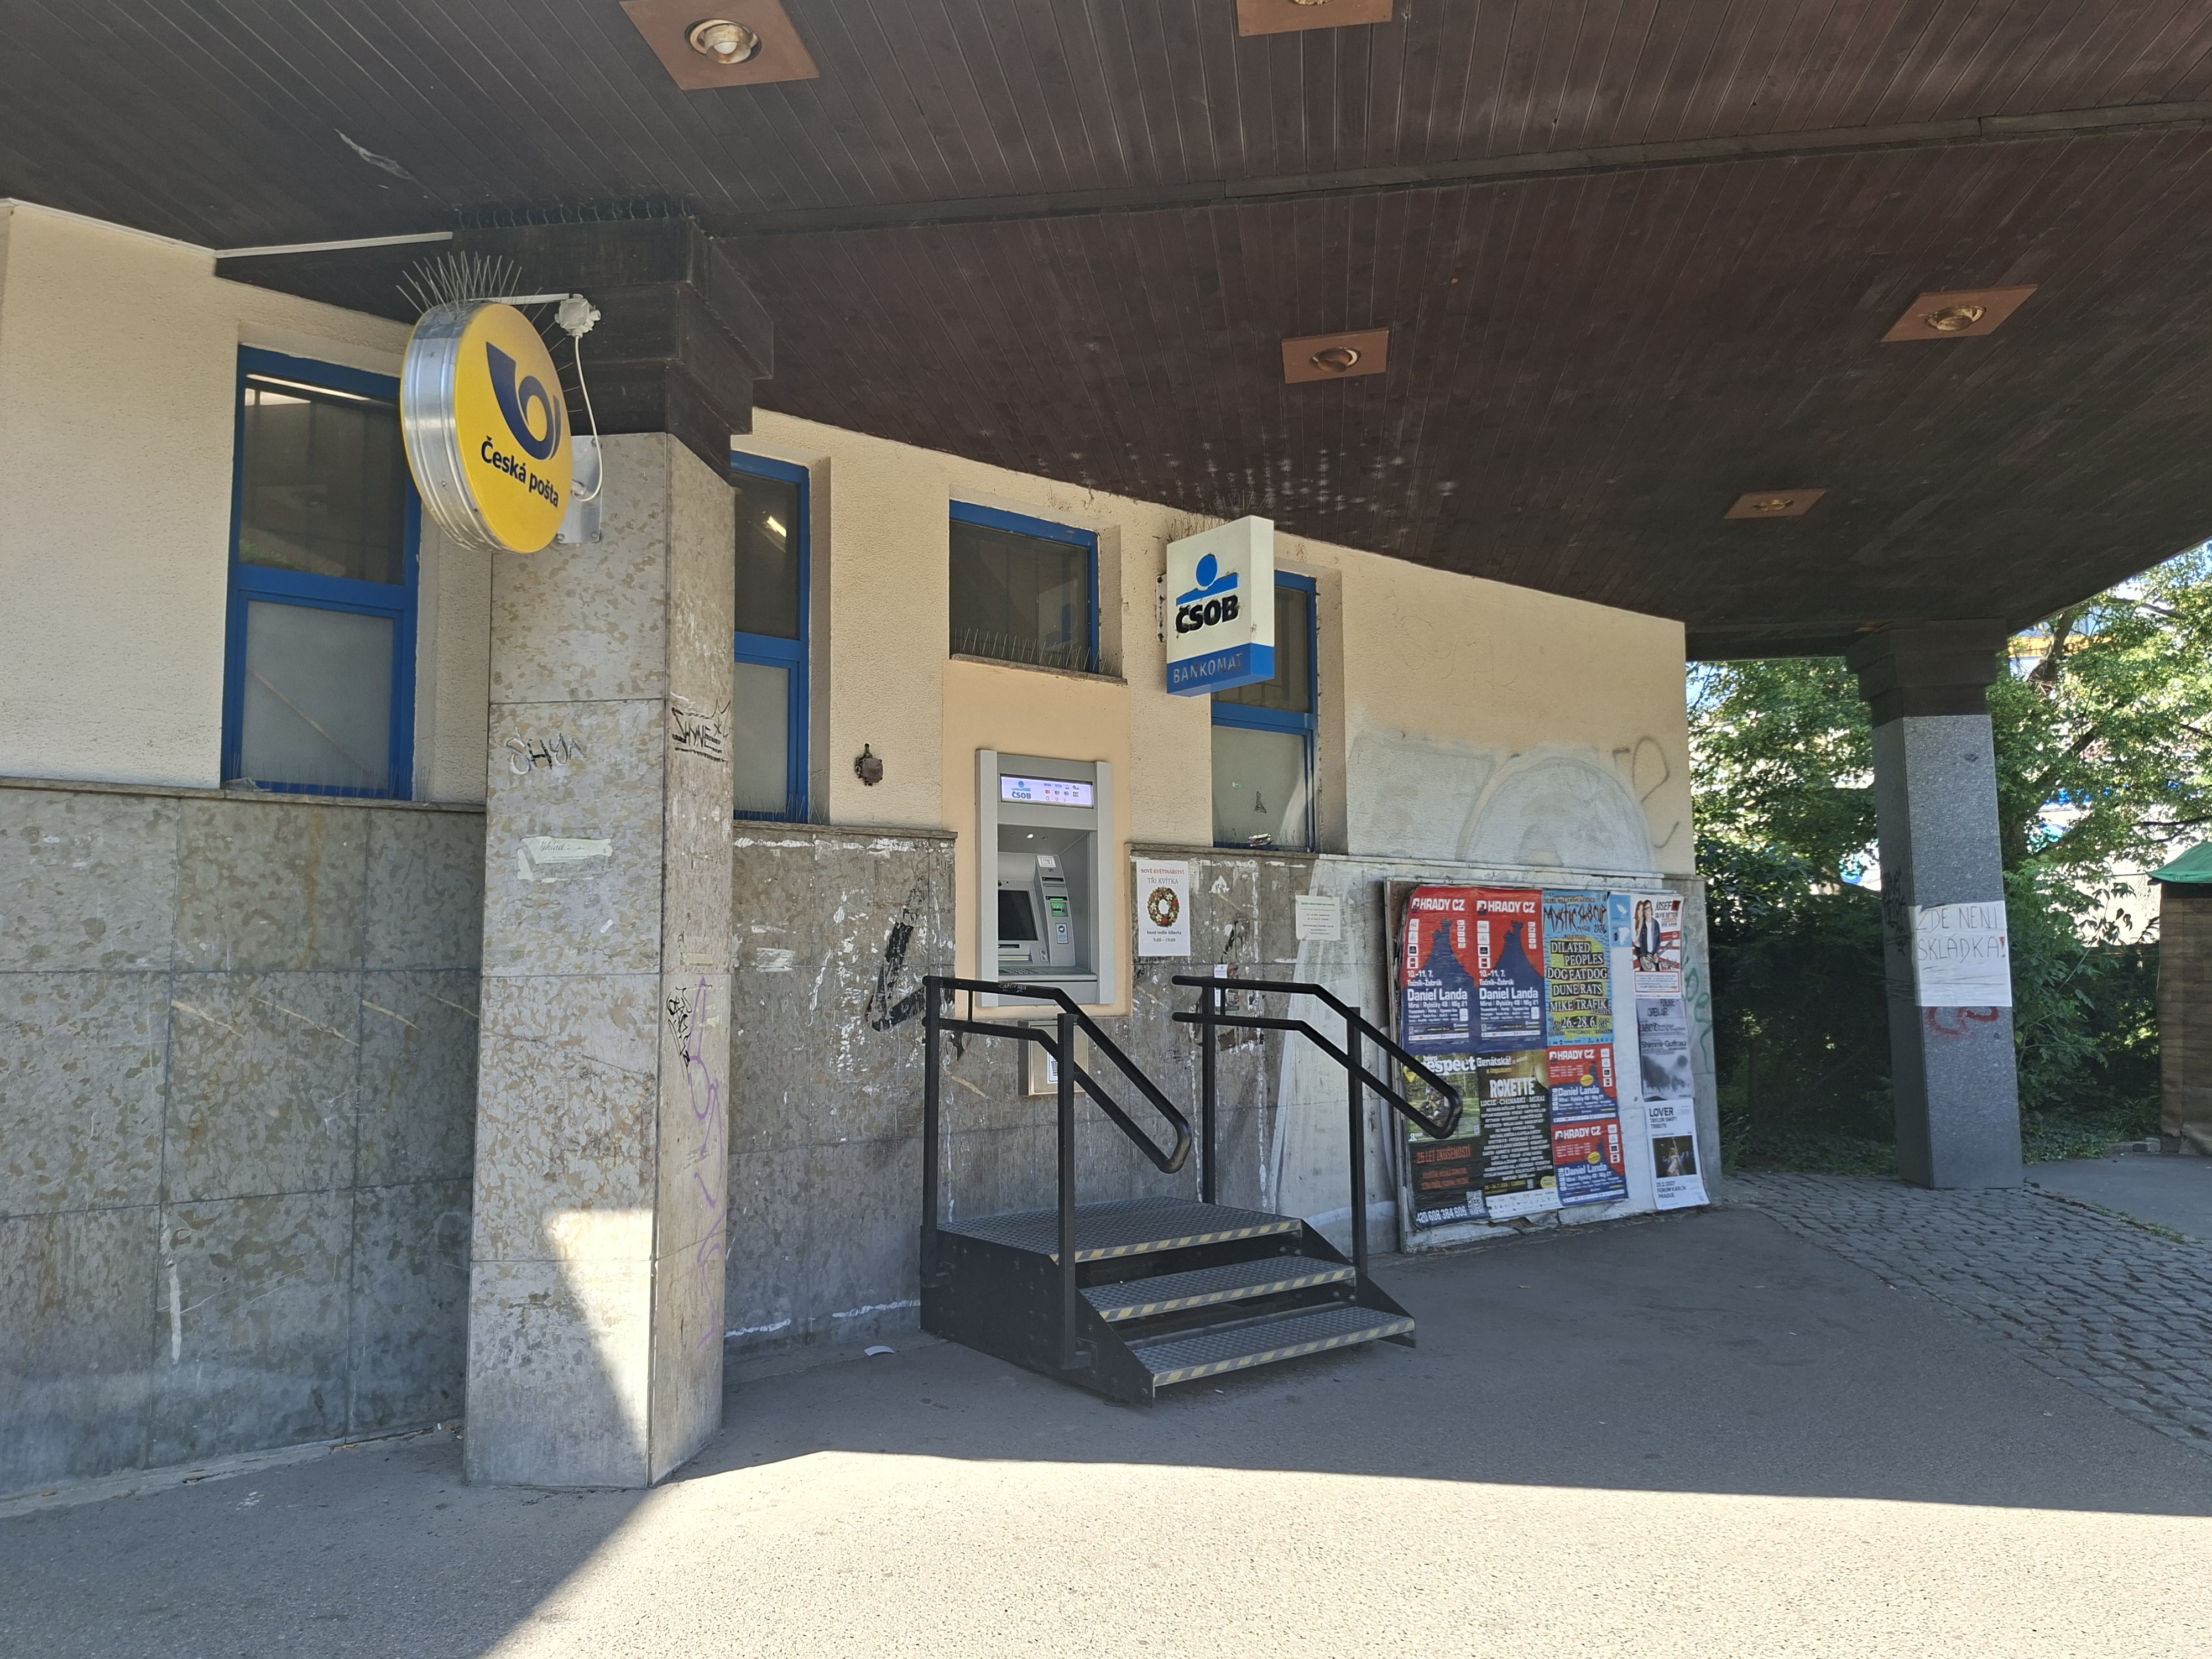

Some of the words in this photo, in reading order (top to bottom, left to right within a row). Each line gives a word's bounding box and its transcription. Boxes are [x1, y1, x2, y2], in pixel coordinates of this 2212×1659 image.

[481, 435, 526, 484] Česká
[529, 472, 559, 508] pošta
[1176, 594, 1239, 633] ČSOB
[1173, 653, 1243, 684] BANKOMAT
[1420, 898, 1452, 911] HRADY
[1452, 899, 1465, 911] CZ
[1488, 901, 1521, 912] HRADY
[1523, 902, 1535, 913] CZ
[1543, 902, 1578, 934] MYSTIC
[1916, 908, 1950, 932] ZDE
[1551, 942, 1590, 953] DILATED
[1917, 933, 2006, 963] SKLÁDKA!
[1565, 953, 1603, 966] PEOPLES
[1548, 968, 1568, 979] DOG
[1569, 969, 1587, 980] EAT
[1587, 968, 1608, 979] DOG
[1407, 988, 1436, 1001] Daniel
[1439, 988, 1467, 1000] Landa
[1479, 987, 1509, 1000] Daniel
[1511, 987, 1538, 1000] Landa
[1553, 984, 1579, 995] DUNE
[1580, 983, 1602, 994] RATS
[1550, 1000, 1573, 1012] MIKE
[1575, 999, 1606, 1010] TRAFIK
[1590, 1016, 1597, 1027] 6.
[1477, 1056, 1511, 1067] Benátská!
[1558, 1050, 1583, 1060] HRADY
[1584, 1050, 1594, 1058] CZ
[1489, 1077, 1536, 1098] ROXETTE
[1558, 1087, 1578, 1096] Daniel
[1579, 1086, 1599, 1094] Landa
[1649, 1107, 1674, 1117] LOVER
[1563, 1127, 1590, 1139] HRADY
[1591, 1126, 1601, 1135] CZ
[1417, 1152, 1425, 1164] 25
[1426, 1150, 1435, 1162] LET
[1436, 1144, 1471, 1161] ZKUŠENOSTÍ
[1564, 1165, 1585, 1176] Daniel
[1587, 1162, 1606, 1173] Landa
